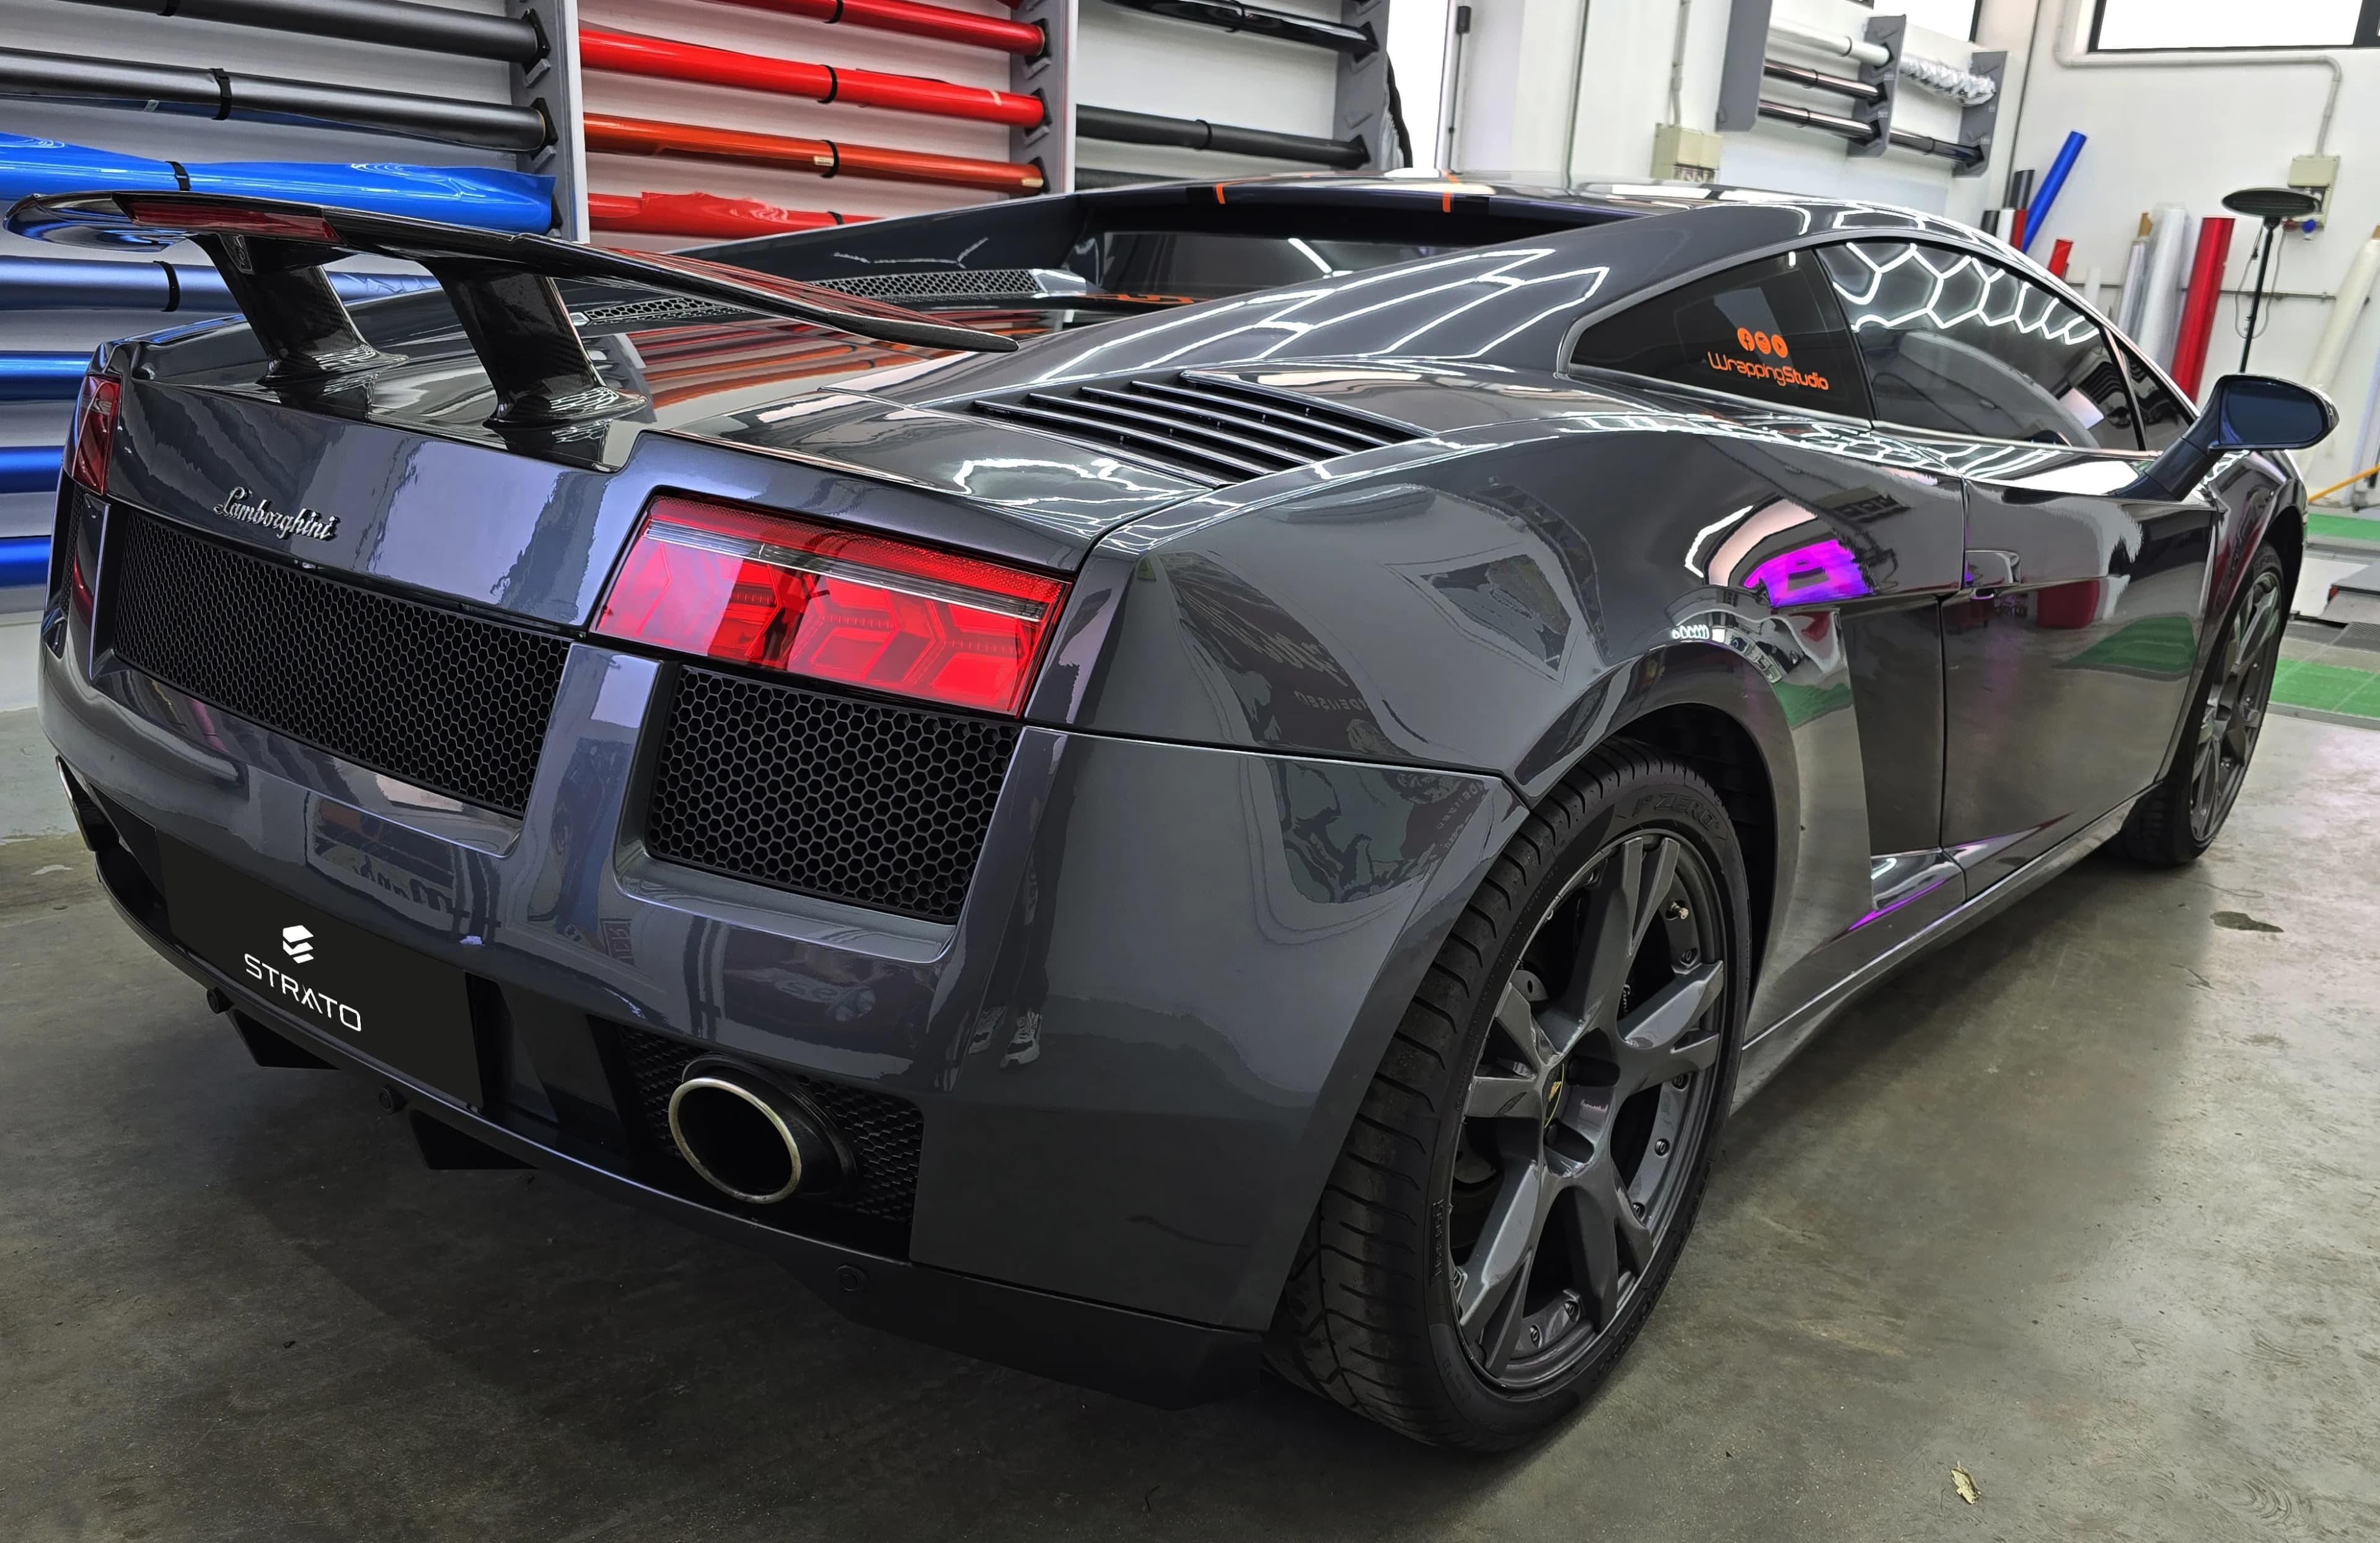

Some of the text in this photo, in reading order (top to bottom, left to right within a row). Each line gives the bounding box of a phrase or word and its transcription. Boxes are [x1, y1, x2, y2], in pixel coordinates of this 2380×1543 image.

[1708, 351, 1829, 390] WrappingStudio
[213, 486, 337, 540] Lamborghini
[1631, 793, 1717, 831] P ZERO
[244, 953, 362, 1032] STRATO
